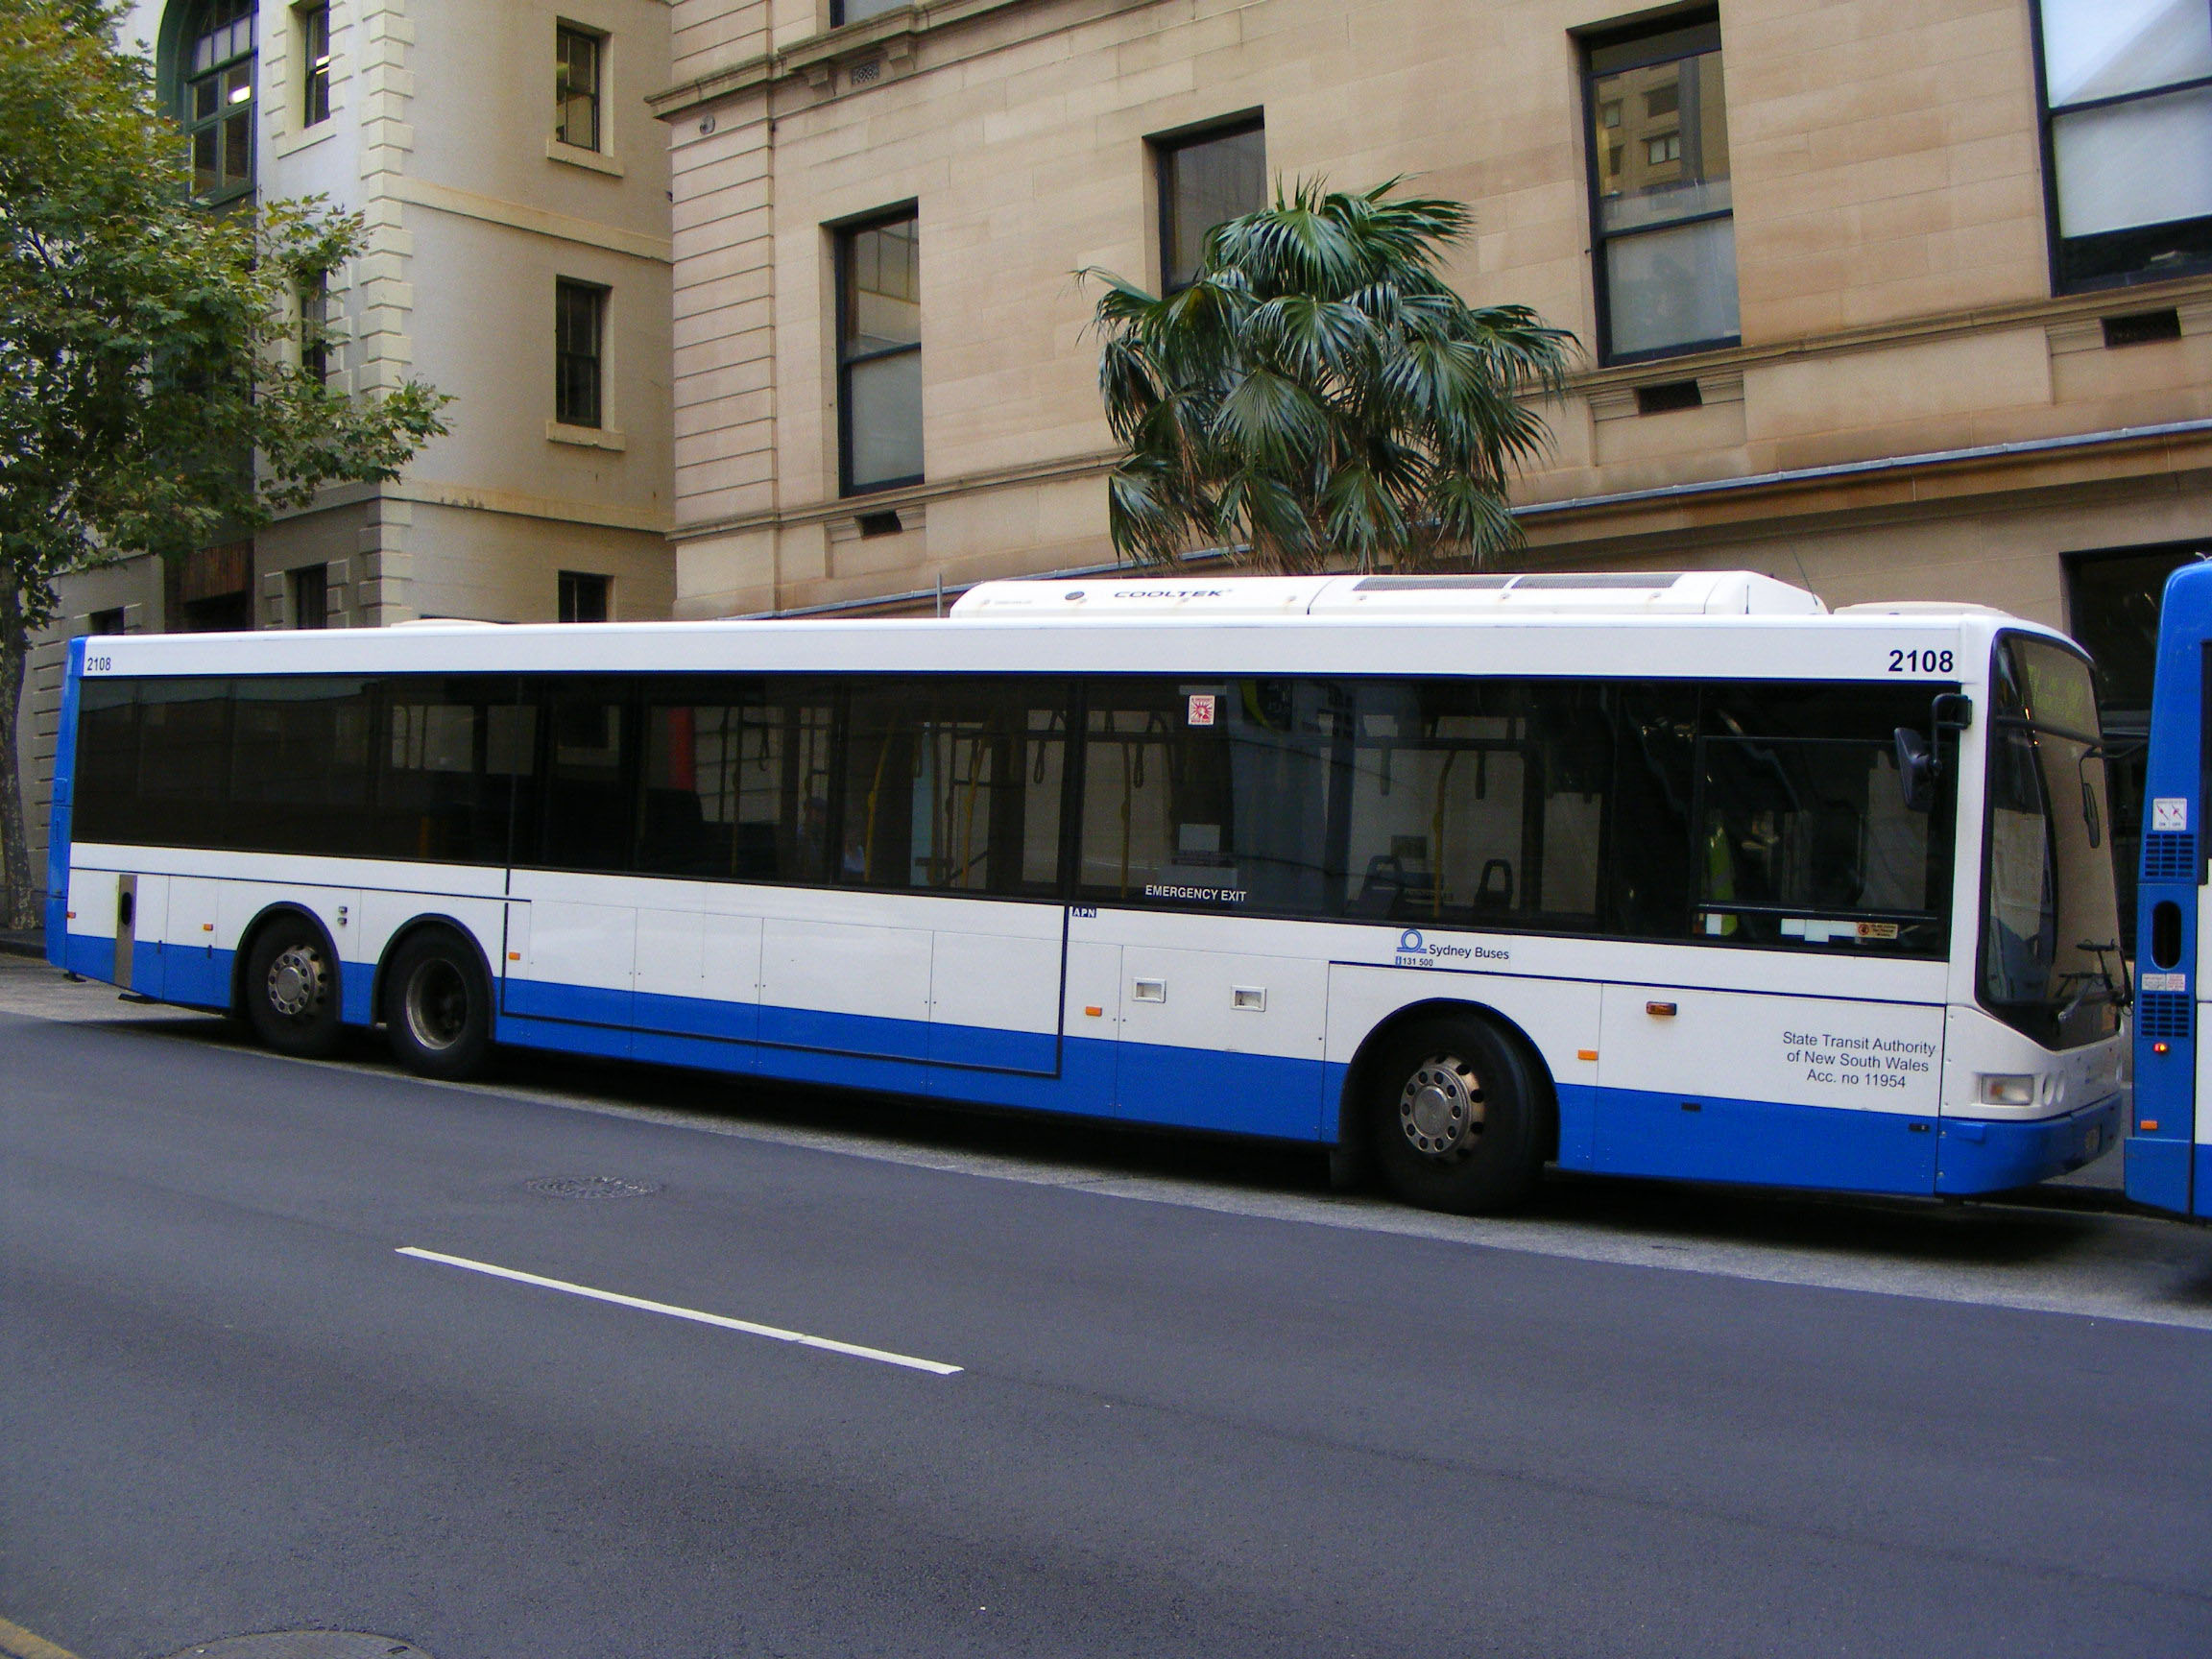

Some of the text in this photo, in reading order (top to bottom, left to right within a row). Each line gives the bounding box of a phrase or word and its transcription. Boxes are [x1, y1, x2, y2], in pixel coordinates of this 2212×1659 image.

[1115, 589, 1223, 598] COOLTEK
[86, 657, 111, 671] 2108
[1888, 649, 1954, 673] 2108
[1145, 884, 1247, 902] EMERGENCY EXIT
[1072, 906, 1096, 918] APN
[1429, 944, 1509, 959] Sydney Buses
[1419, 958, 1433, 967] 500
[1783, 1031, 1936, 1057] State Transit Authority
[1787, 1049, 1929, 1072] of New South Wales
[1807, 1069, 1906, 1088] Acc. no 11954
